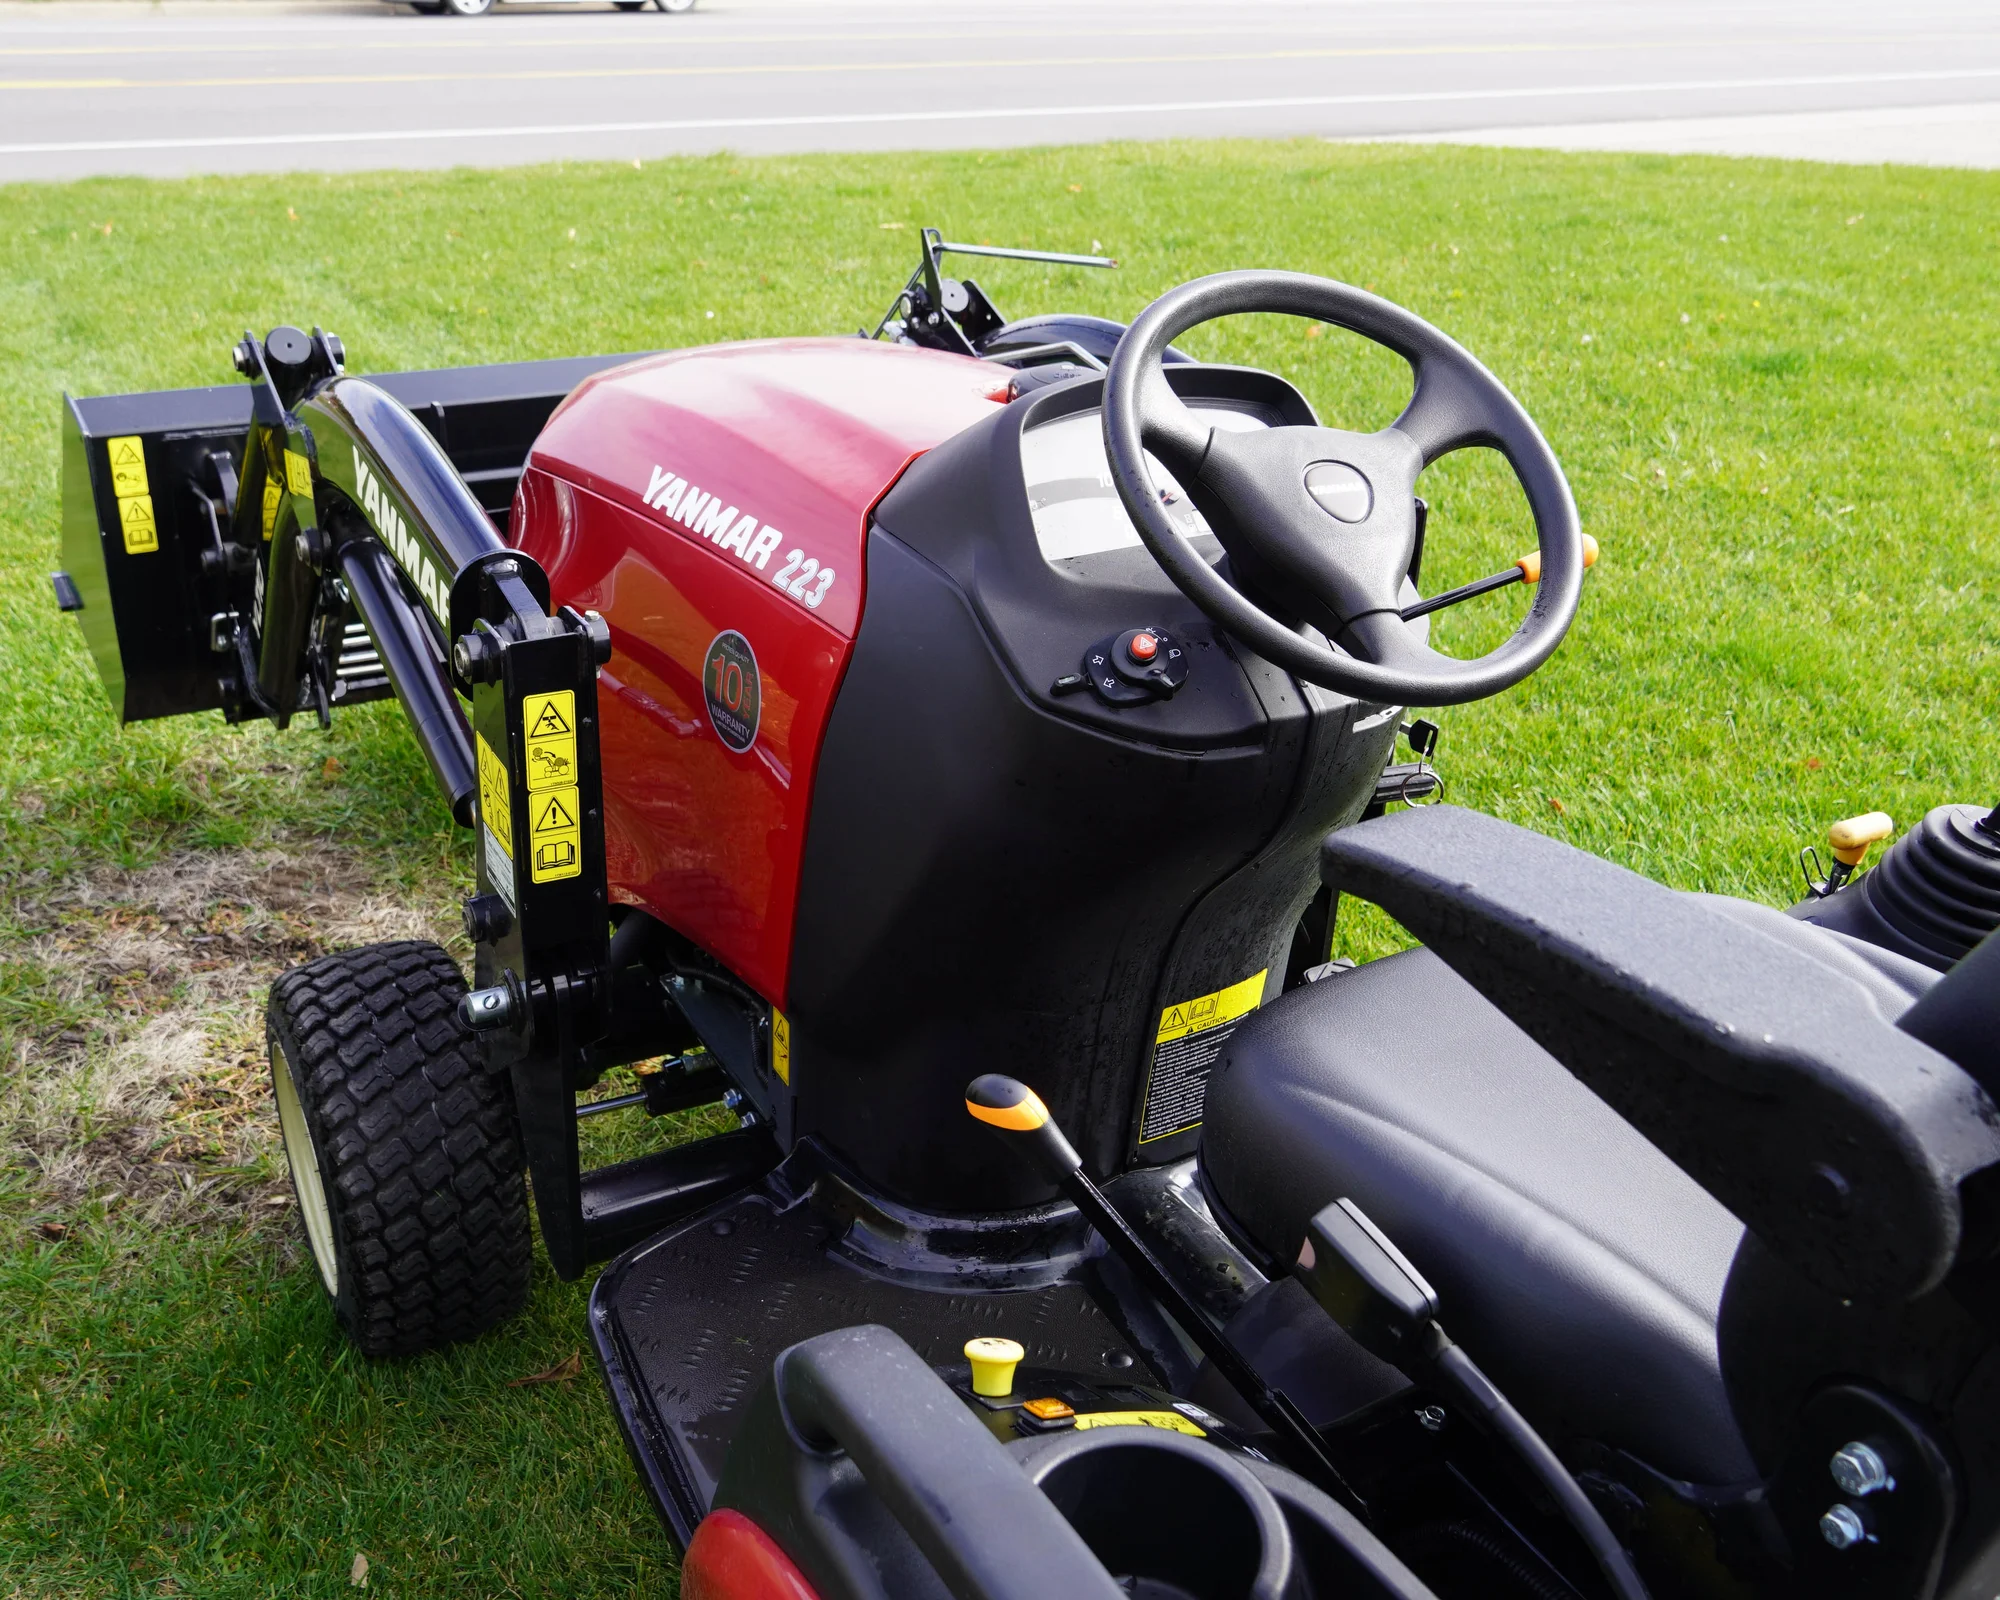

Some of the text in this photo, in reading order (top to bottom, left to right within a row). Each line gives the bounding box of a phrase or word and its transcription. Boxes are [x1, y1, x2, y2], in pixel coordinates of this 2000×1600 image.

[642, 465, 836, 609] YANMAR 223
[712, 653, 743, 713] 10
[743, 671, 754, 719] YEAR
[711, 702, 750, 739] WARRANTY
[1196, 1015, 1228, 1030] CAUTION
